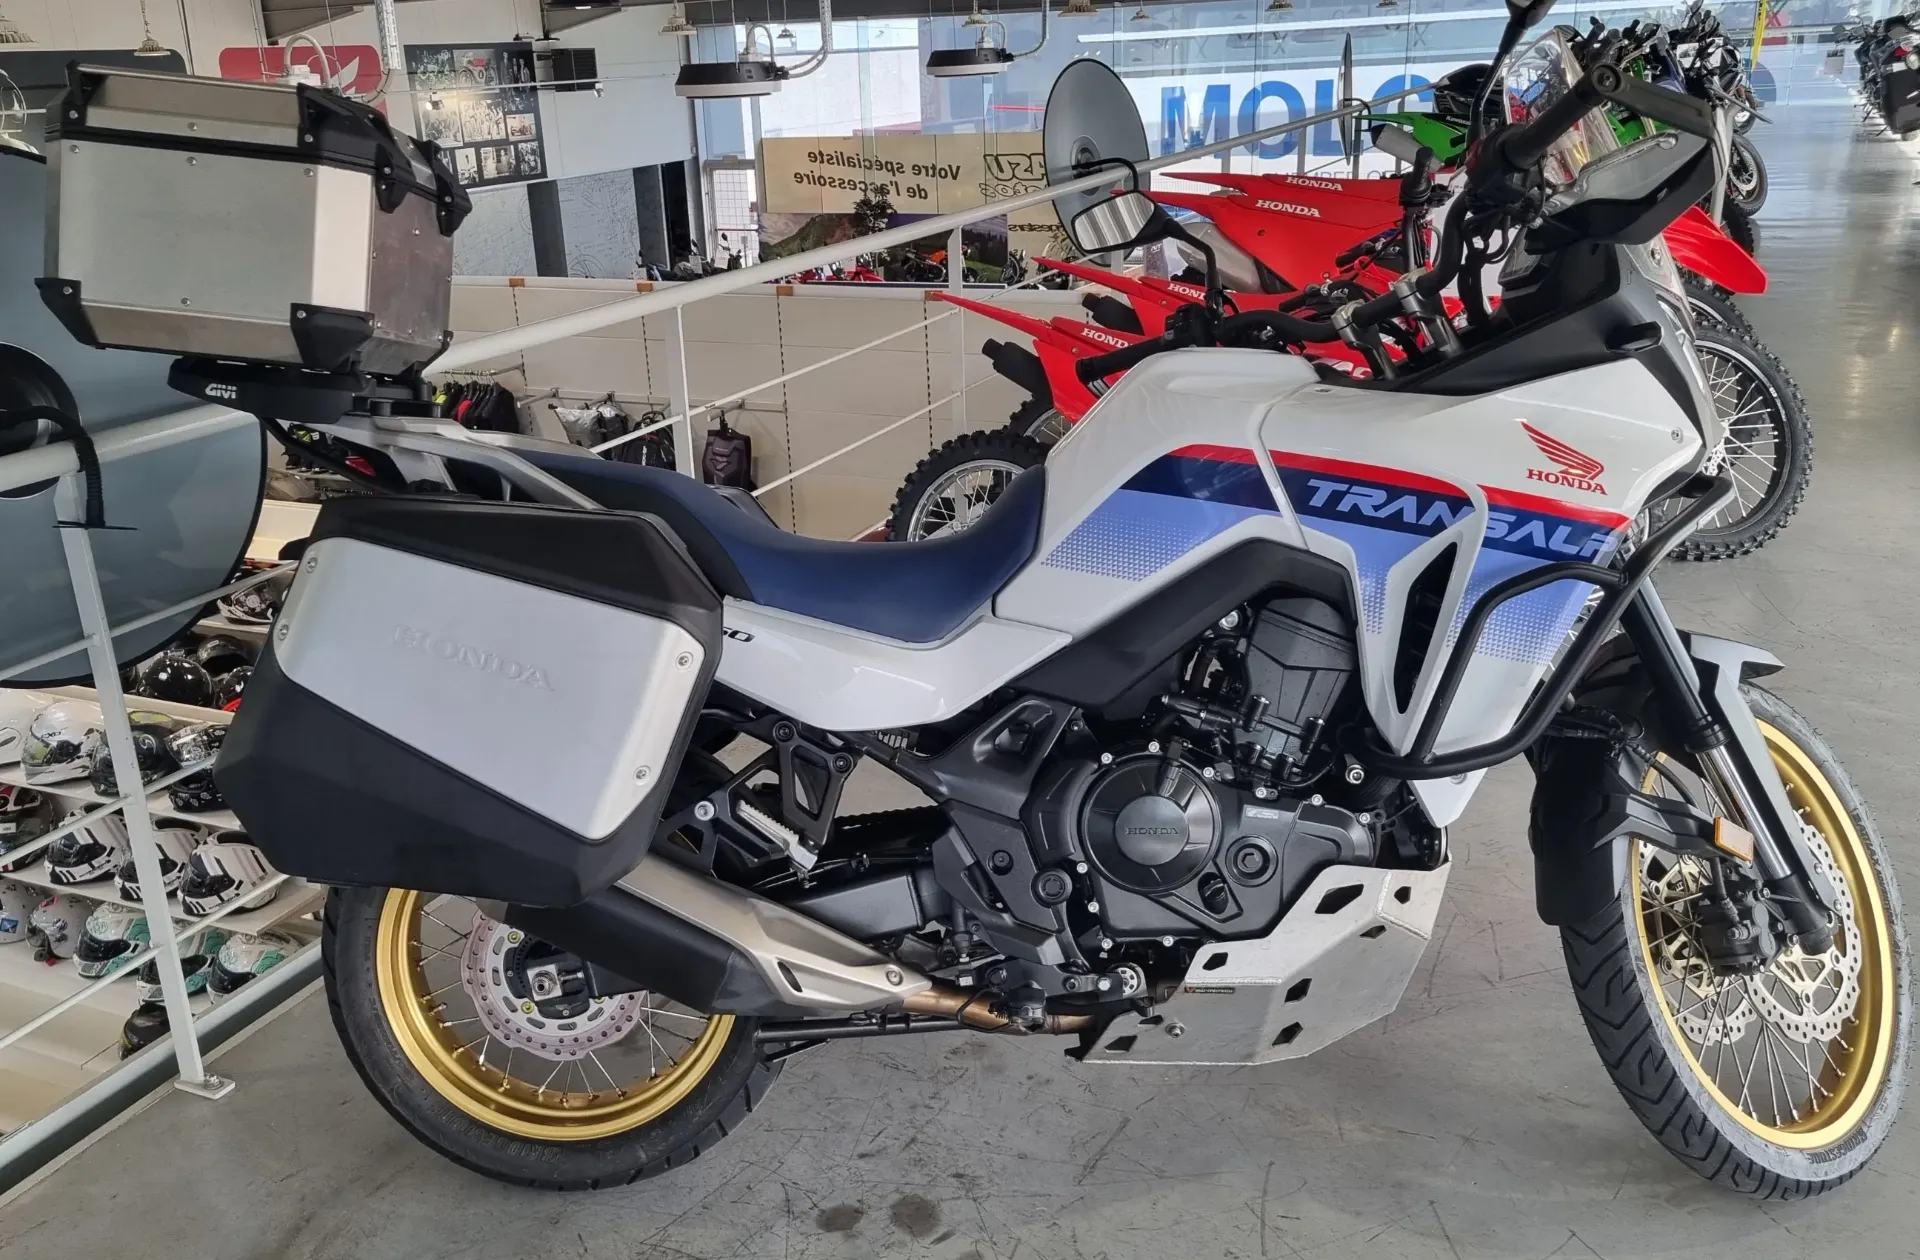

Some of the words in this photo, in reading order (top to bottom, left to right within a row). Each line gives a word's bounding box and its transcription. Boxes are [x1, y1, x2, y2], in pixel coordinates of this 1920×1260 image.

[1285, 176, 1343, 192] HONDA
[1255, 200, 1321, 217] HONDA
[1167, 283, 1206, 301] HON
[1081, 327, 1133, 349] HOND
[1526, 468, 1608, 496] HONDA
[392, 622, 555, 692] HONDA
[1125, 827, 1179, 835] HONDA
[1805, 1126, 1868, 1165] BRIDGESTONE
